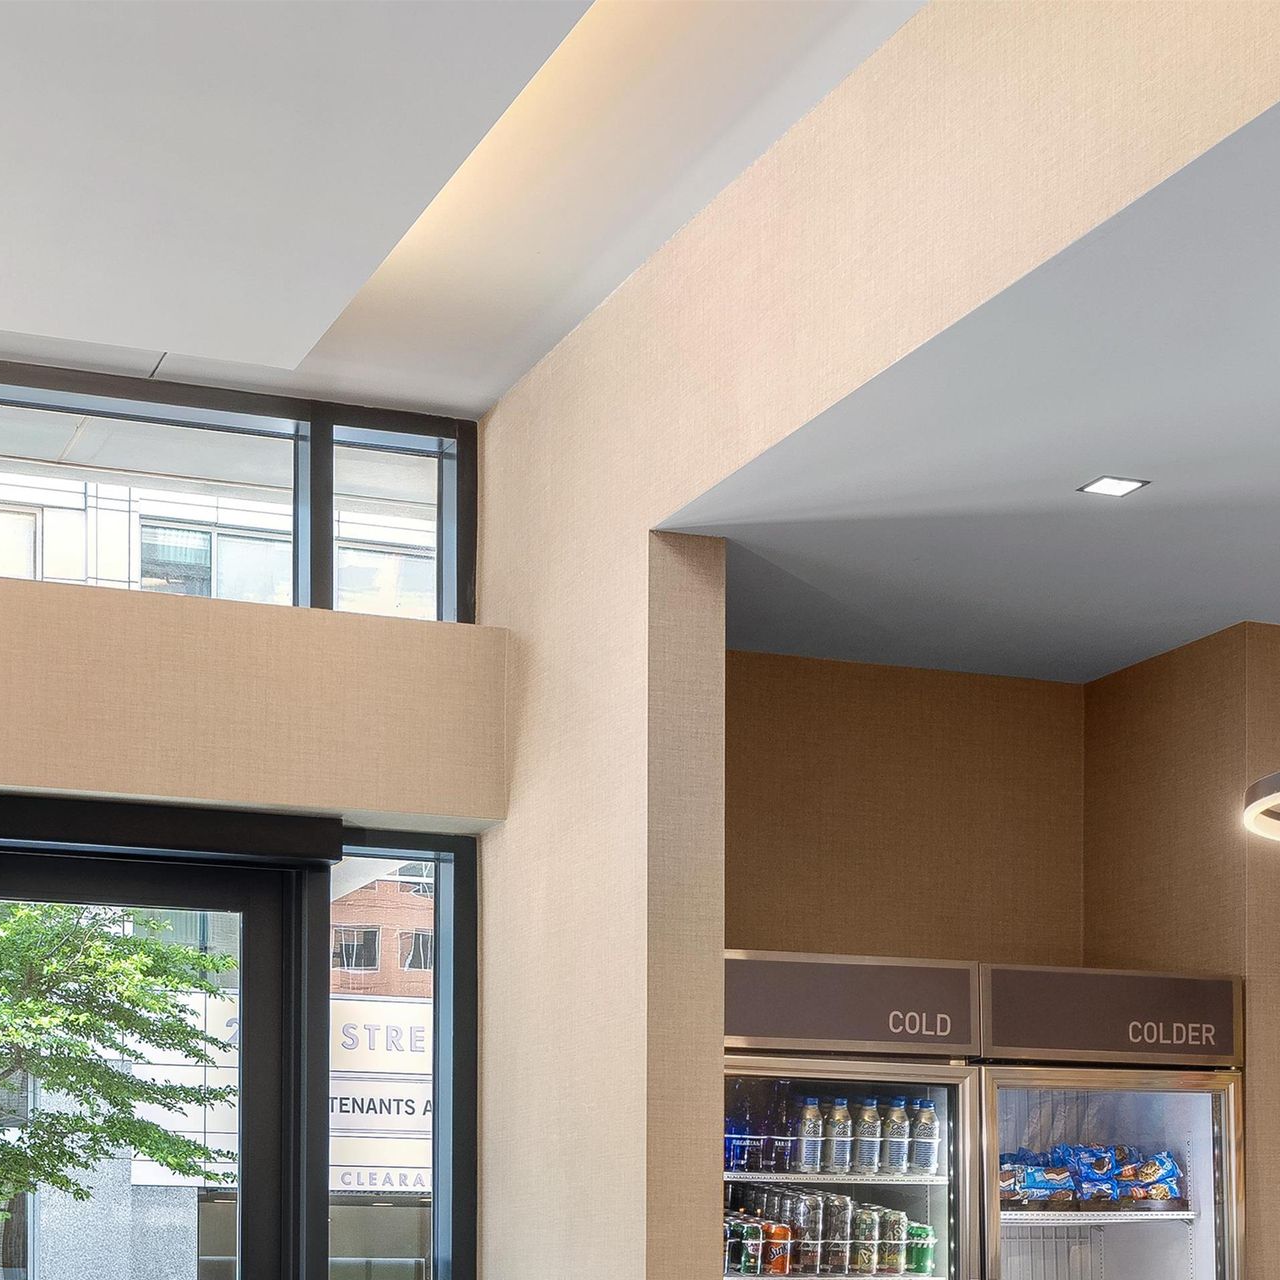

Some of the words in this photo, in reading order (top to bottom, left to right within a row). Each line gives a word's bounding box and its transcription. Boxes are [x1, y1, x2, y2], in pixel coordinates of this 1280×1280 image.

[888, 1010, 952, 1037] COLD
[1128, 1020, 1216, 1046] COLDER
[341, 1023, 426, 1053] STRE
[329, 1096, 416, 1116] TENANTS
[340, 1171, 431, 1188] CLEARA
